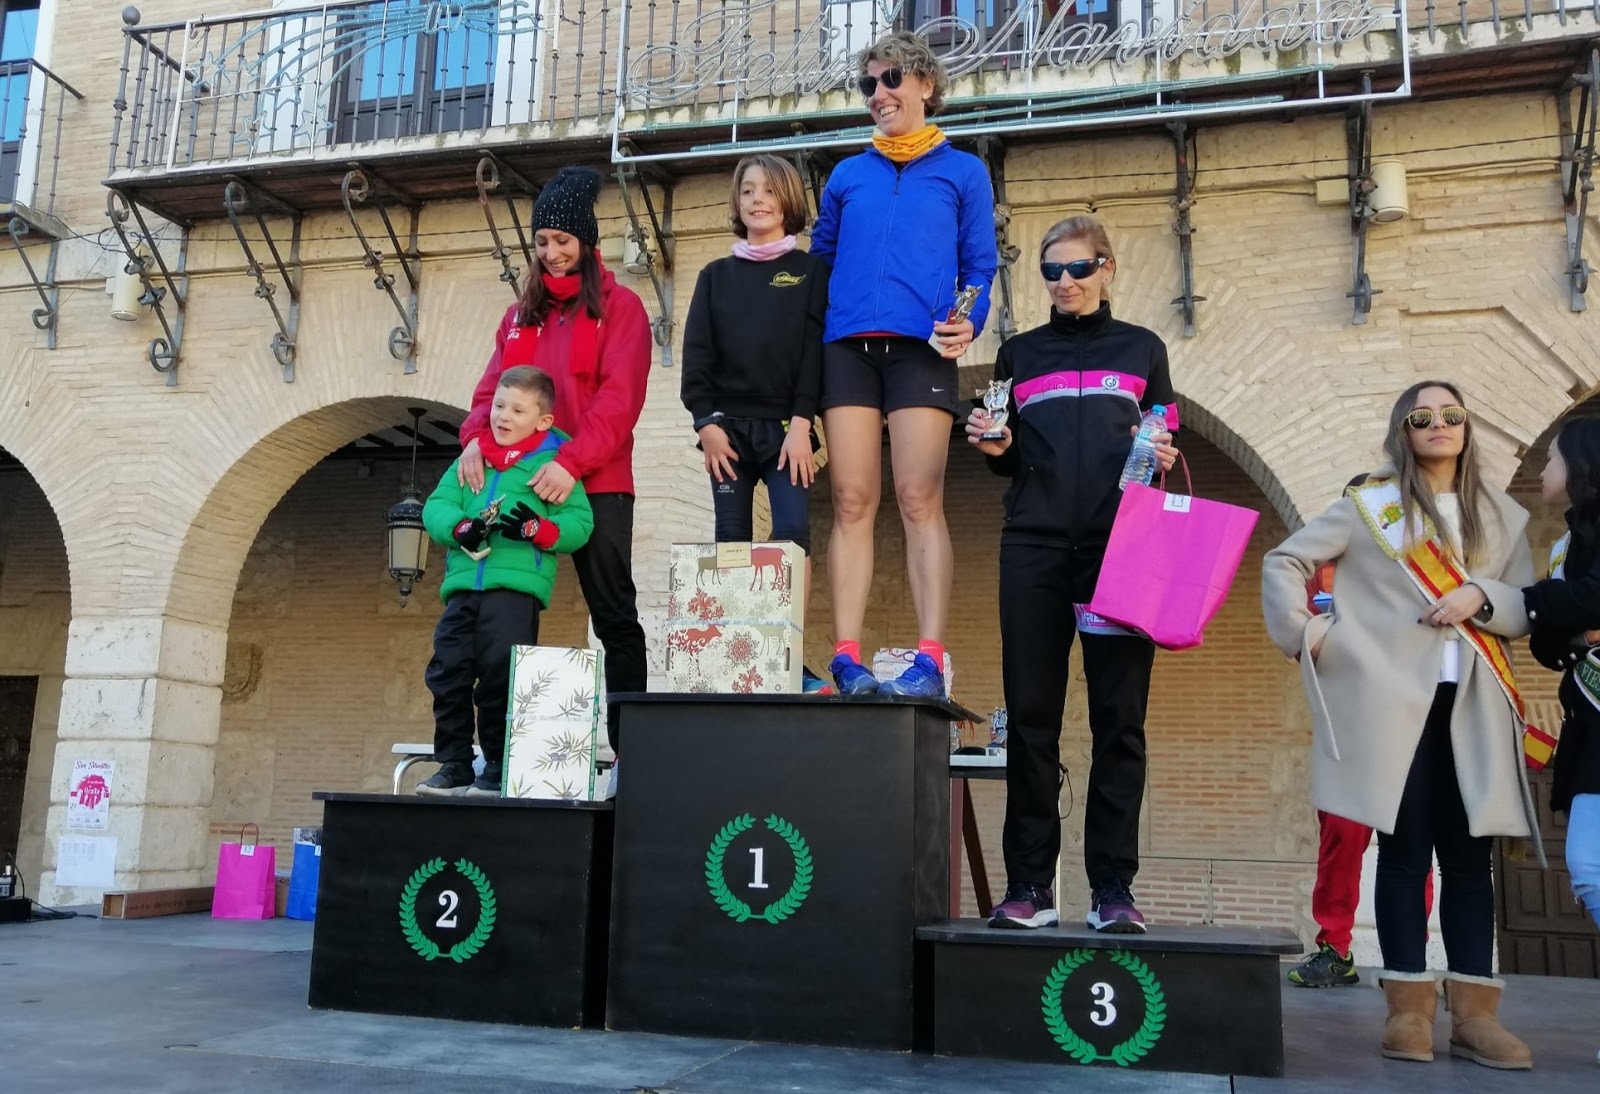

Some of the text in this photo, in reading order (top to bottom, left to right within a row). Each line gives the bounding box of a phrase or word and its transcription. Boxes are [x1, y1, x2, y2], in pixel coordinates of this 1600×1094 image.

[914, 0, 1382, 78] Navidad
[747, 847, 769, 889] 1
[435, 889, 459, 928] 2
[1089, 981, 1117, 1027] 3
